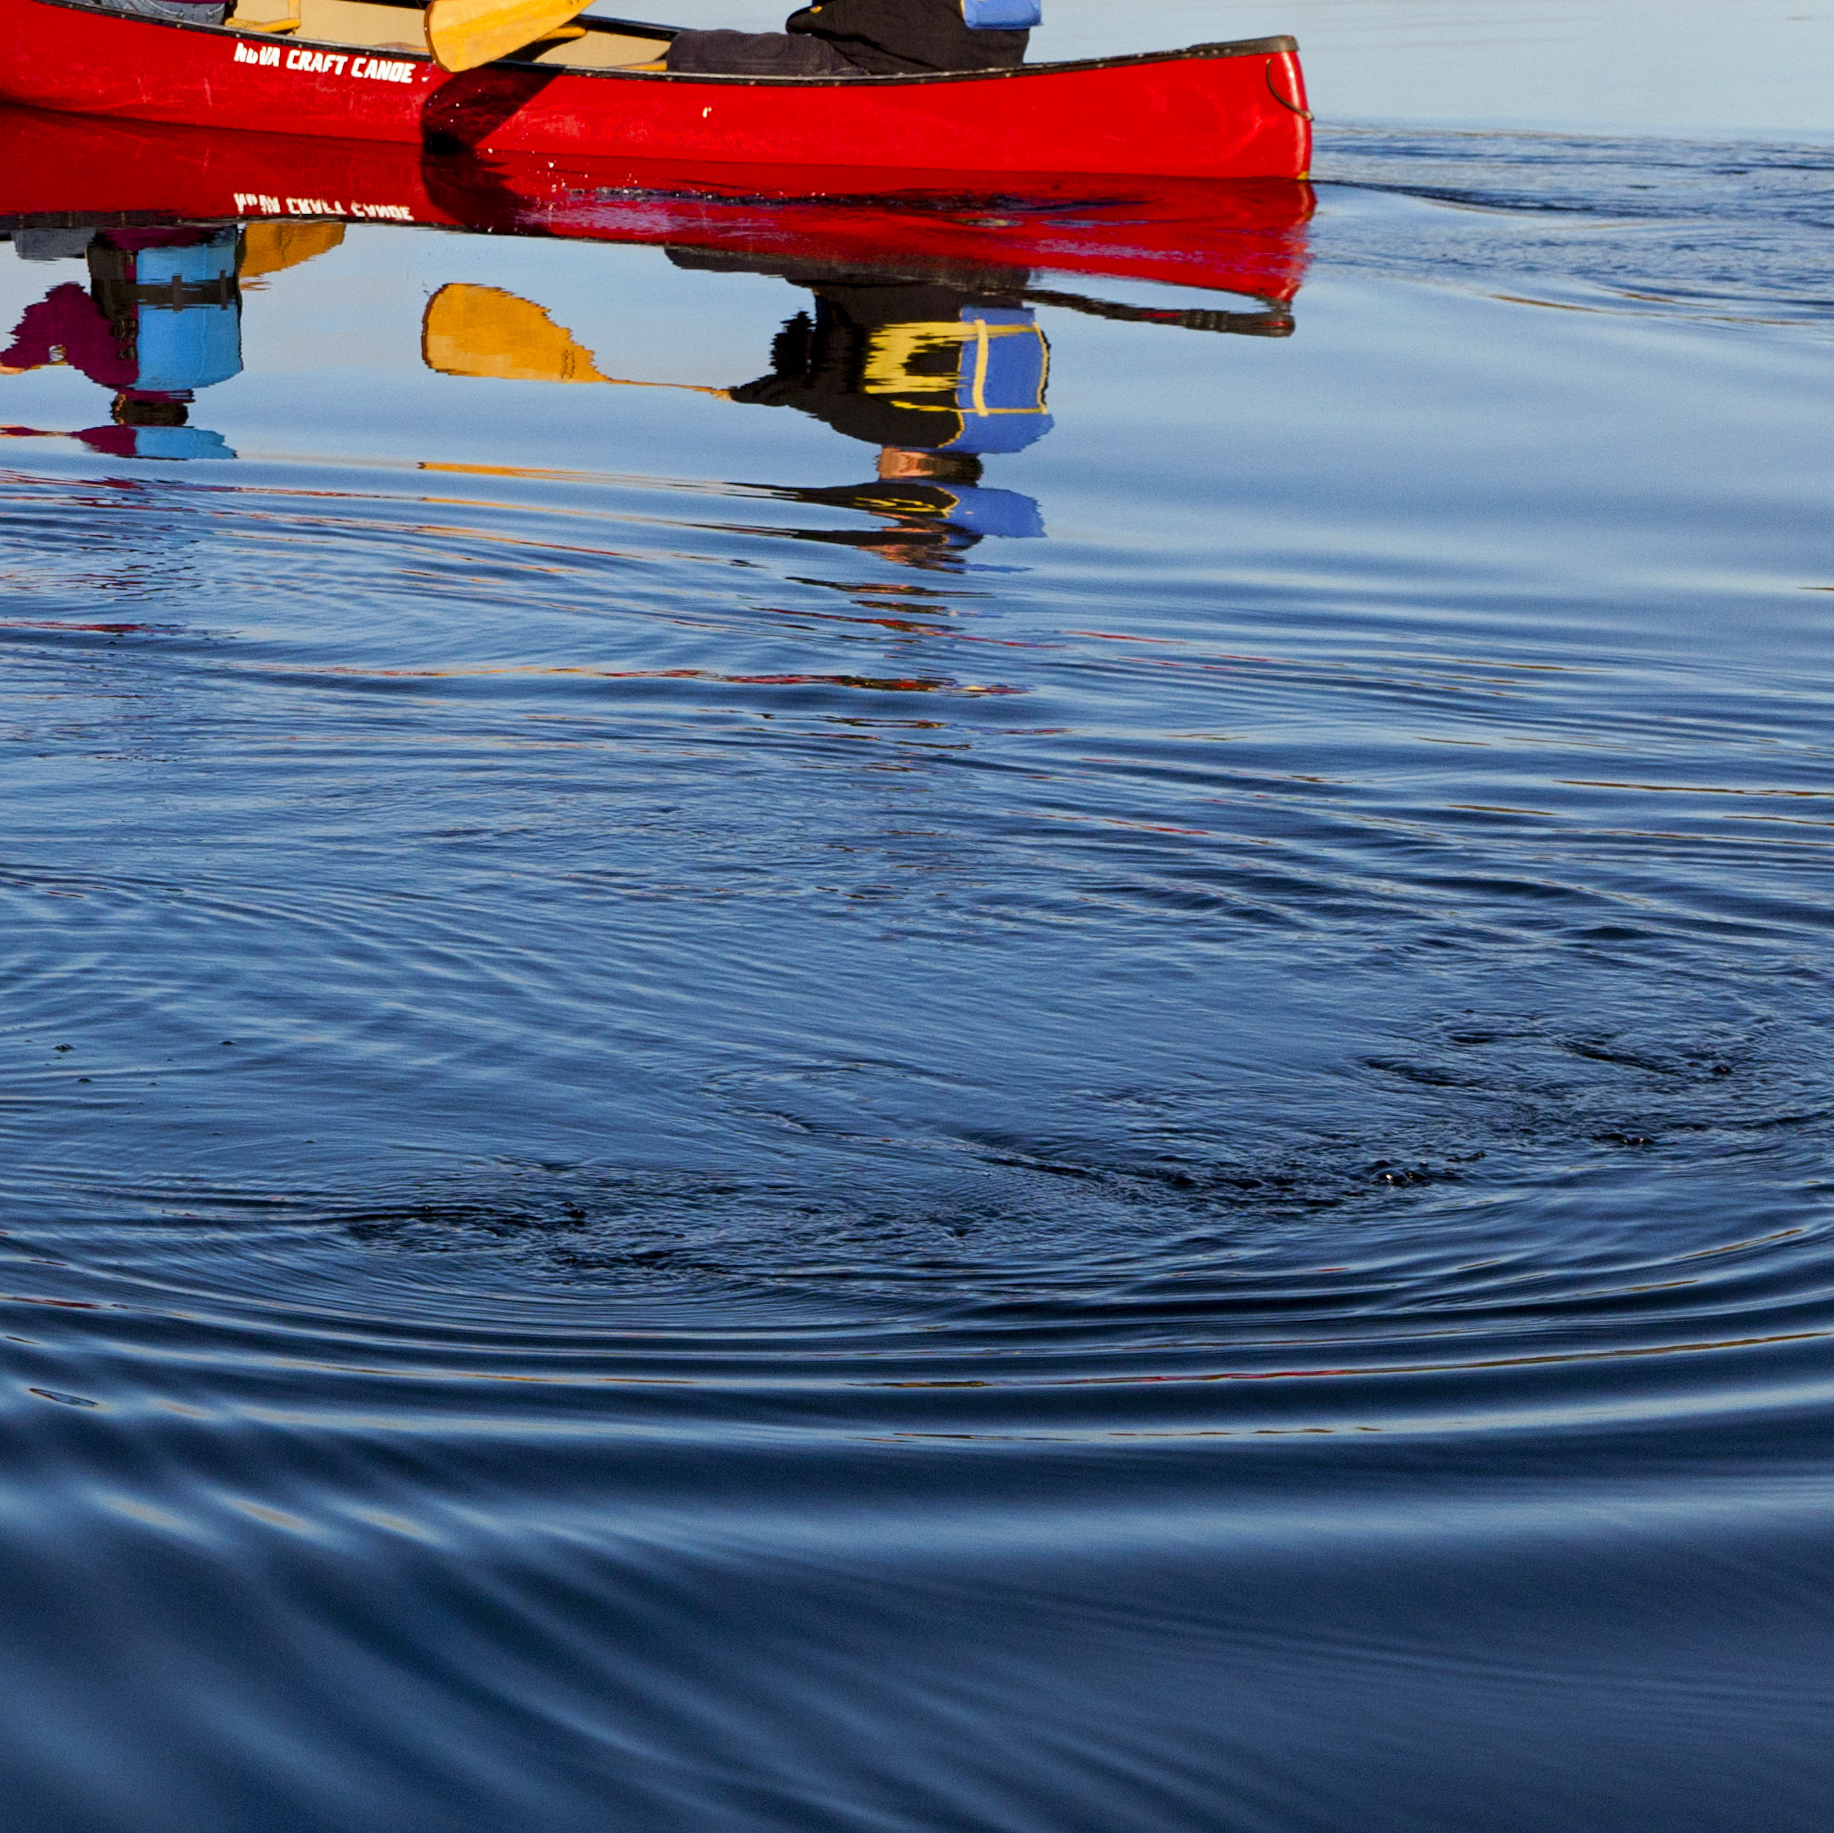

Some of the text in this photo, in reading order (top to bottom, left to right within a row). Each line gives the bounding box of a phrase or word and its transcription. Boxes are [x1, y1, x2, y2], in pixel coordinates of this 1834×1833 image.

[234, 42, 417, 84] NOVA CRAFT CANOE
